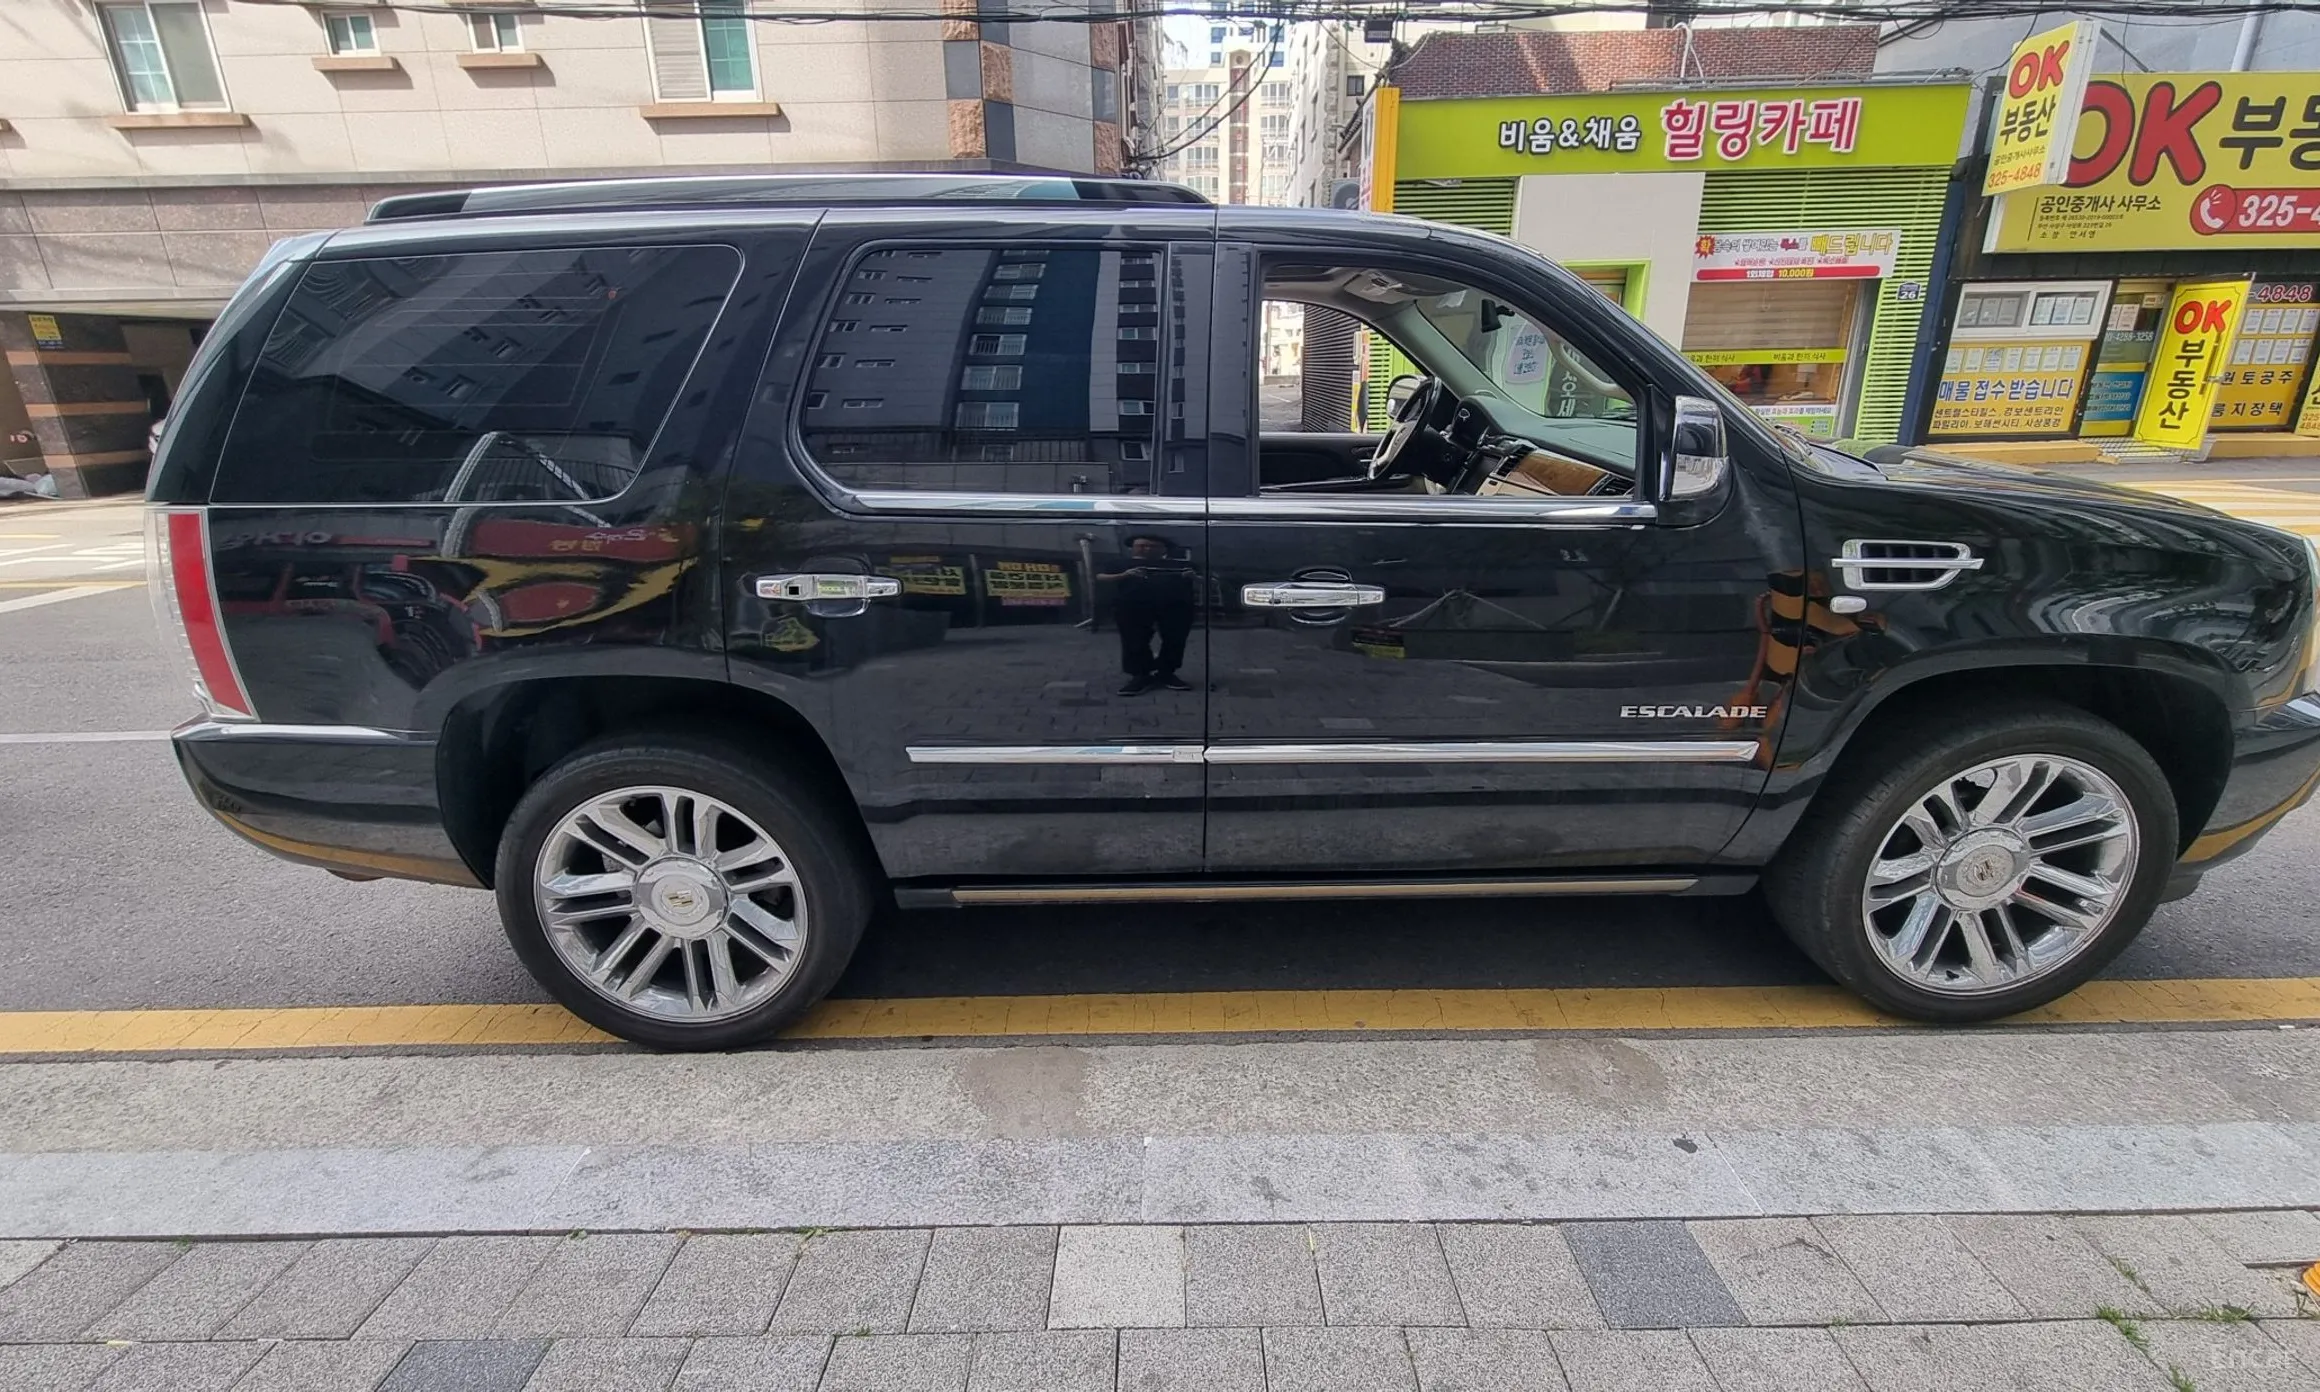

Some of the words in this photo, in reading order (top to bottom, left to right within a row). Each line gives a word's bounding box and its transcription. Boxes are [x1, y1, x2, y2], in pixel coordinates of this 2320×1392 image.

[2009, 40, 2070, 99] OK
[1499, 115, 1641, 154] 비움&채움
[1661, 97, 1863, 162] 힐링카페
[2000, 94, 2057, 147] 부동산
[2062, 80, 2223, 188] OK
[1993, 145, 2046, 167] 공인중개사사무소
[1987, 162, 2043, 189] 325-4848
[2040, 195, 2115, 214] 공인중개사
[2117, 195, 2162, 213] 사무소
[1811, 232, 1894, 256] 빼드립니다
[1899, 291, 1917, 300] 26
[2174, 300, 2231, 335] OK
[1938, 380, 1971, 401] 매물
[1973, 379, 2006, 401] 접수
[2008, 378, 2074, 401] 받습니다
[2159, 339, 2206, 430] 부동산
[1620, 706, 1768, 718] ESCALADE
